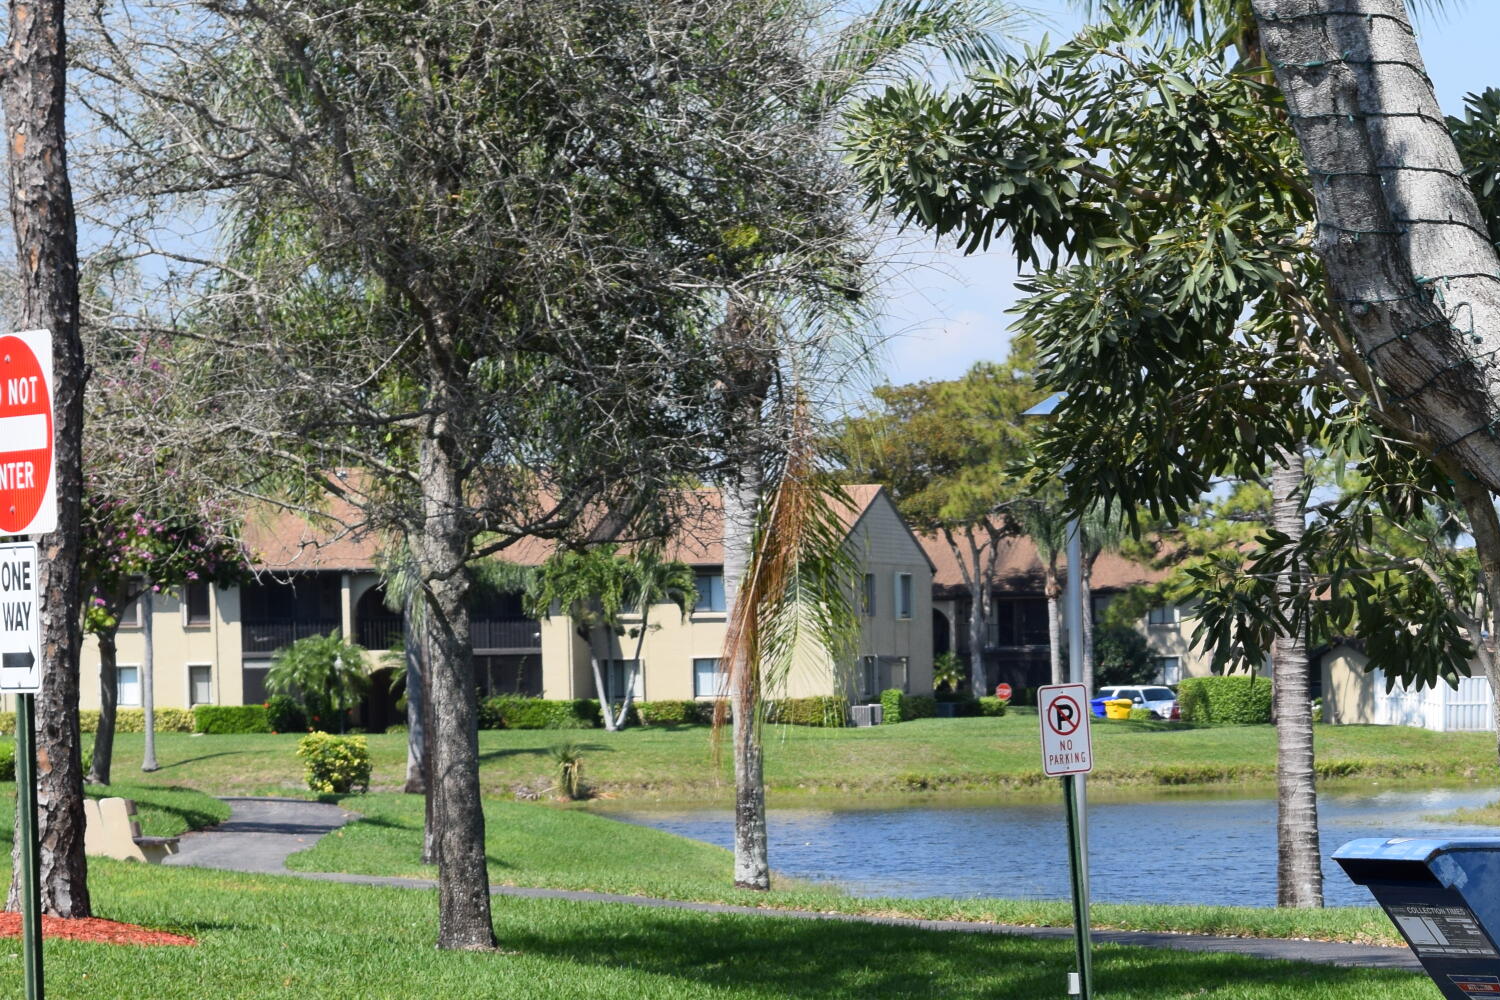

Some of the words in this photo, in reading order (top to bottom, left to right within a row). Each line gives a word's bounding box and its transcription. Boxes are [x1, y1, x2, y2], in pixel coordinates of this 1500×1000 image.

[8, 376, 38, 406] NOT
[0, 461, 34, 491] NTER
[1, 561, 32, 592] ONE
[2, 601, 32, 632] WAY
[1049, 752, 1086, 766] PARKING
[1059, 739, 1073, 751] NO
[1406, 906, 1446, 915] COLLECTION
[1446, 907, 1466, 916] TIMES
